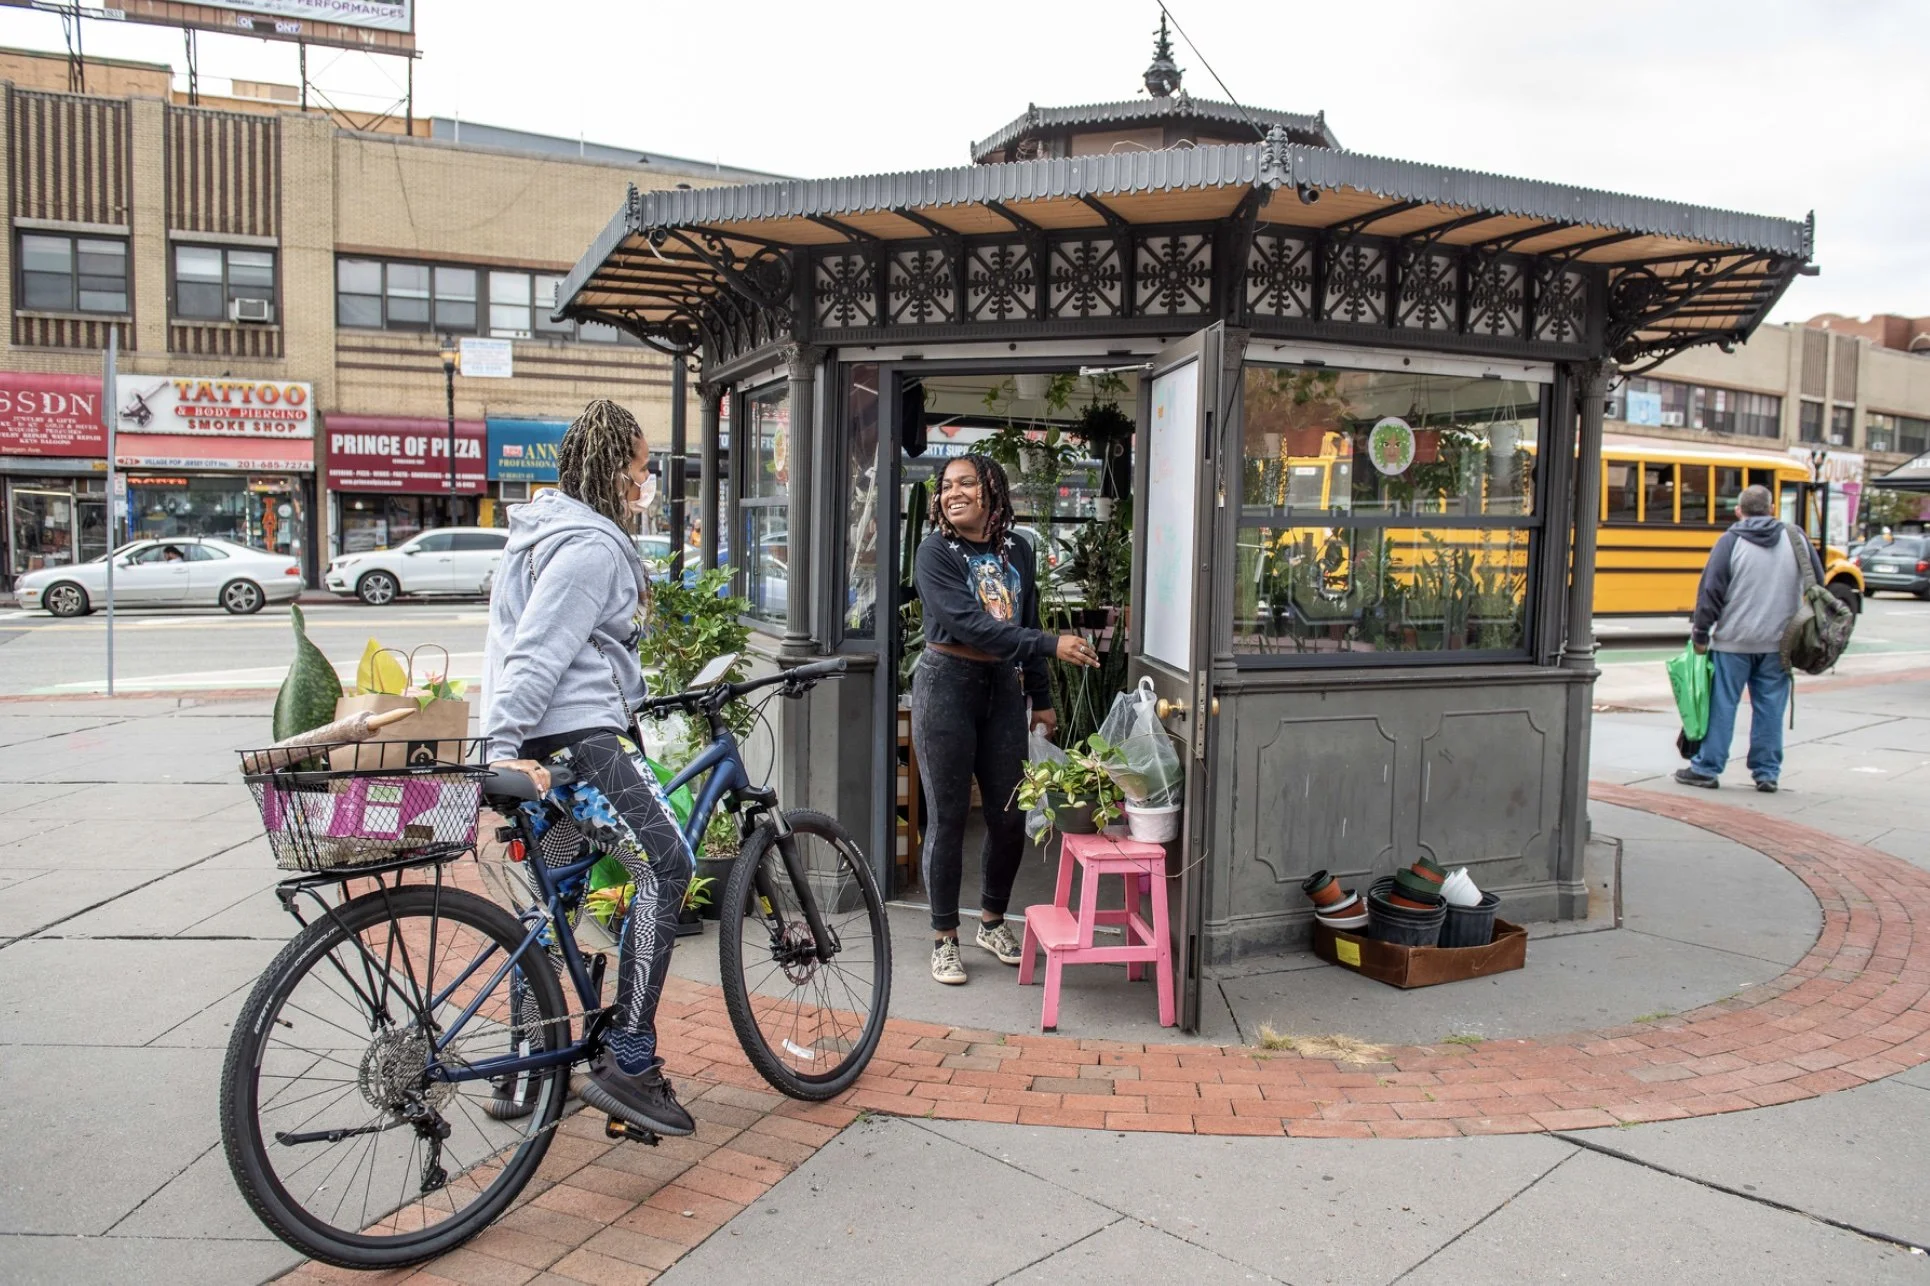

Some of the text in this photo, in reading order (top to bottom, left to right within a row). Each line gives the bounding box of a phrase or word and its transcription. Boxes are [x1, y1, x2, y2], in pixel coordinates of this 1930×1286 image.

[173, 379, 307, 406] TATTOO
[177, 407, 304, 420] & BODY PIERCING
[188, 419, 297, 433] SMOKE SHOP
[331, 433, 400, 456] PRINCE
[404, 436, 427, 457] OF
[238, 460, 310, 469] 201-685-7274
